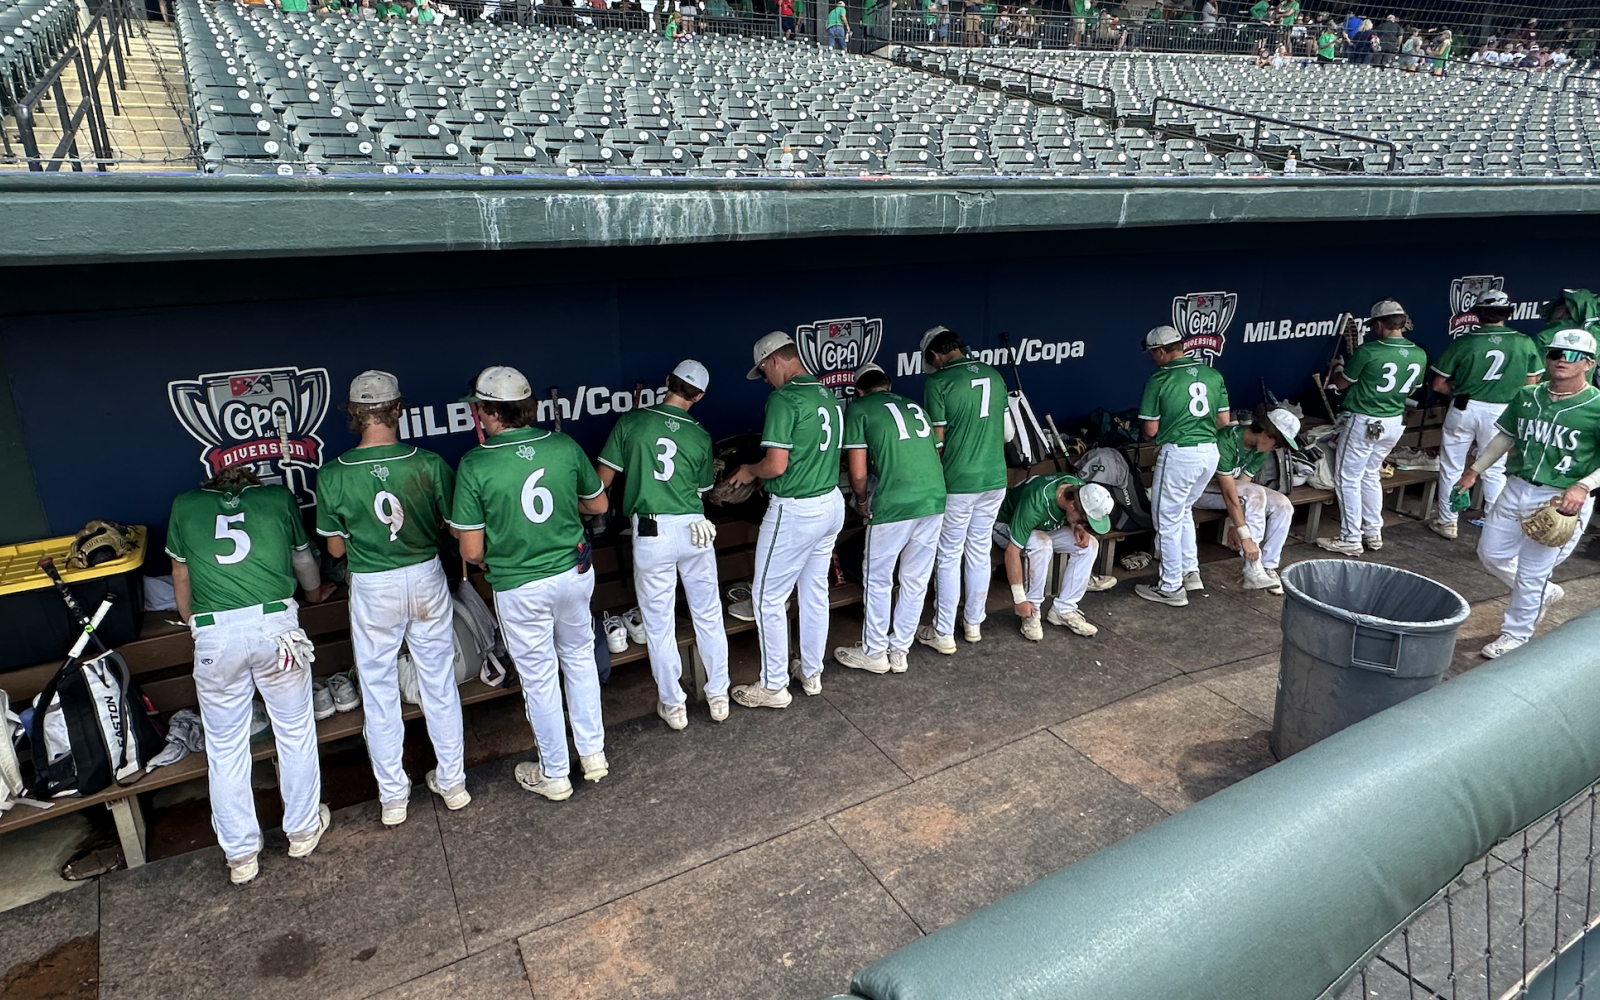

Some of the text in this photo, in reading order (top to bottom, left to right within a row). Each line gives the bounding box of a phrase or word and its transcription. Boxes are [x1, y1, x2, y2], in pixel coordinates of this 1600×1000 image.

[1376, 362, 1422, 394] 32
[1482, 350, 1505, 381] 2
[971, 377, 991, 418] 7
[1188, 381, 1211, 417] 8
[817, 405, 844, 451] 31
[884, 402, 931, 440] 13
[1517, 417, 1582, 451] HAWKS
[653, 437, 677, 481] 3
[1554, 455, 1573, 475] 4
[374, 490, 404, 542] 9
[520, 467, 553, 524] 6
[214, 512, 251, 565] 5
[104, 696, 124, 748] EASTON
